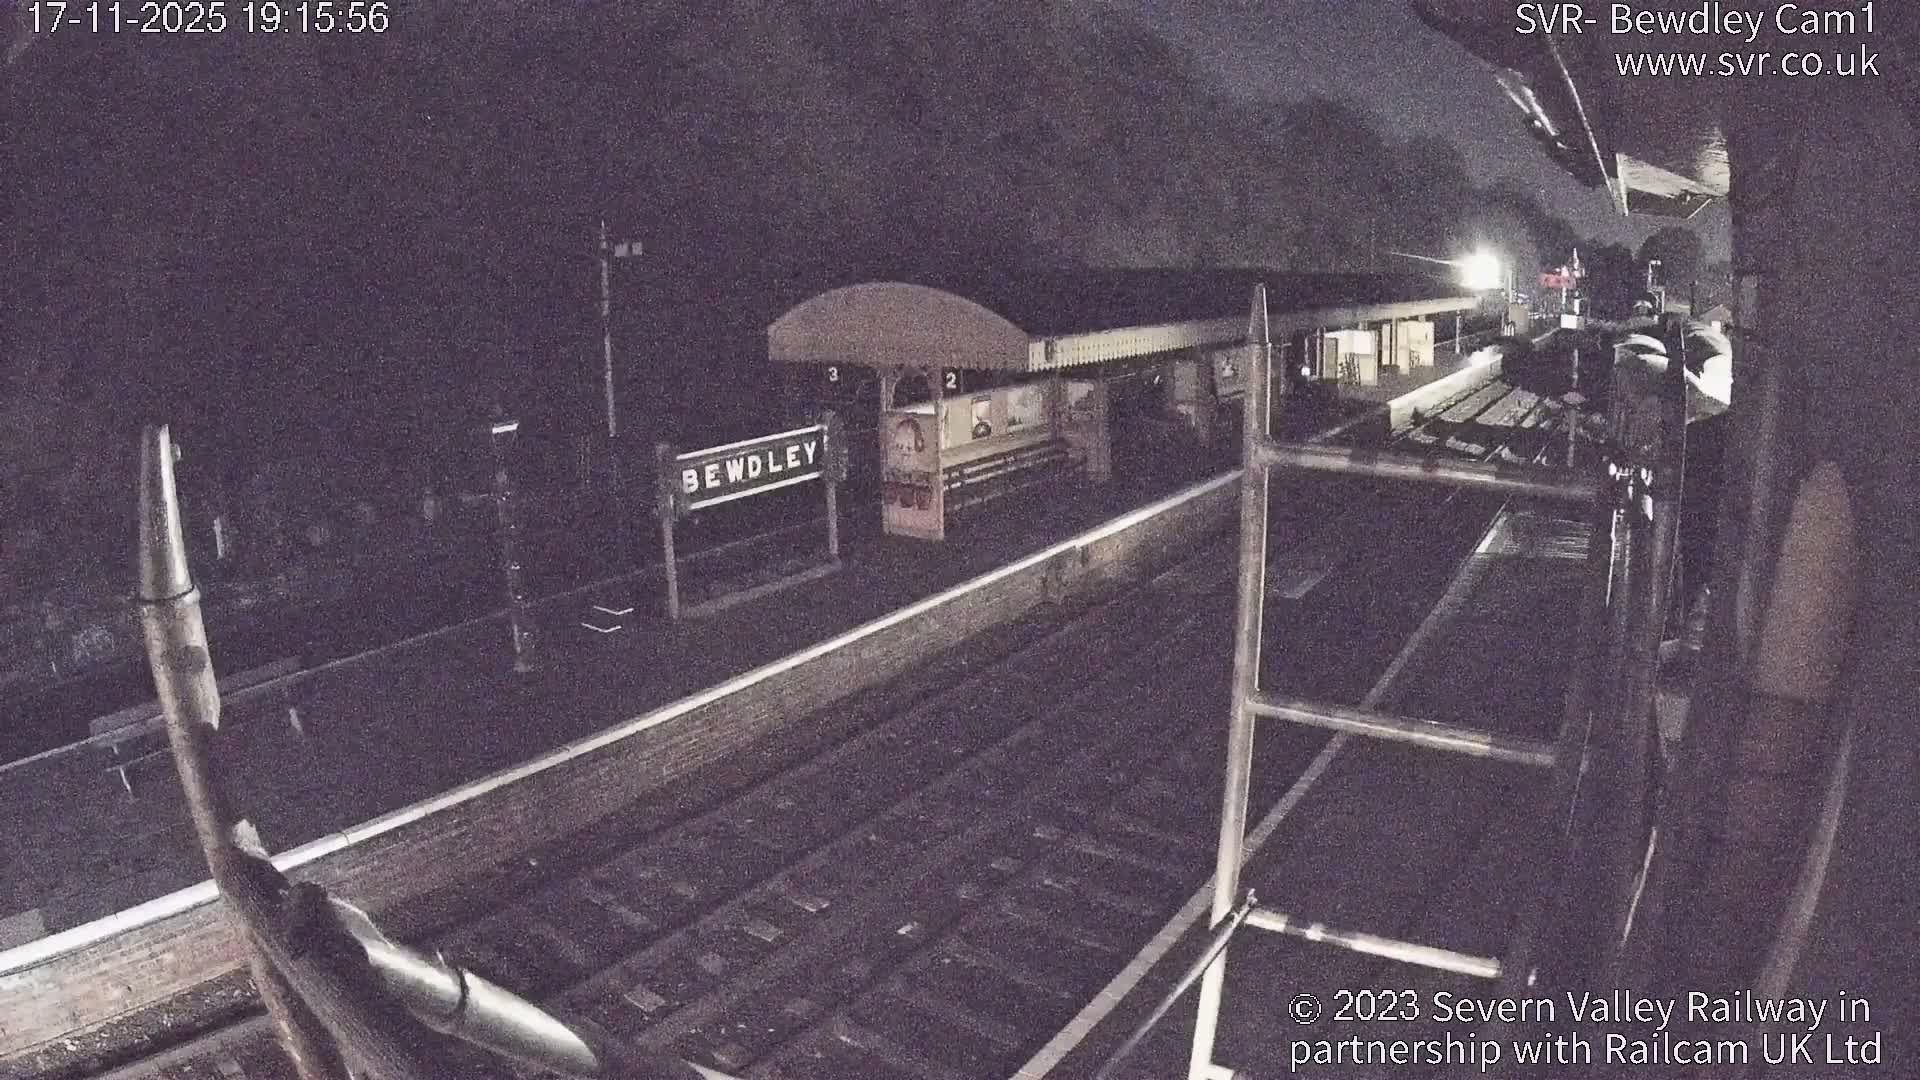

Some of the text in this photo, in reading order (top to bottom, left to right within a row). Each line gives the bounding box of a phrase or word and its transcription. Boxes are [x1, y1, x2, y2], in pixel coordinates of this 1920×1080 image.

[828, 366, 839, 382] 3
[945, 371, 957, 389] 2
[681, 441, 817, 494] BEWDLEY
